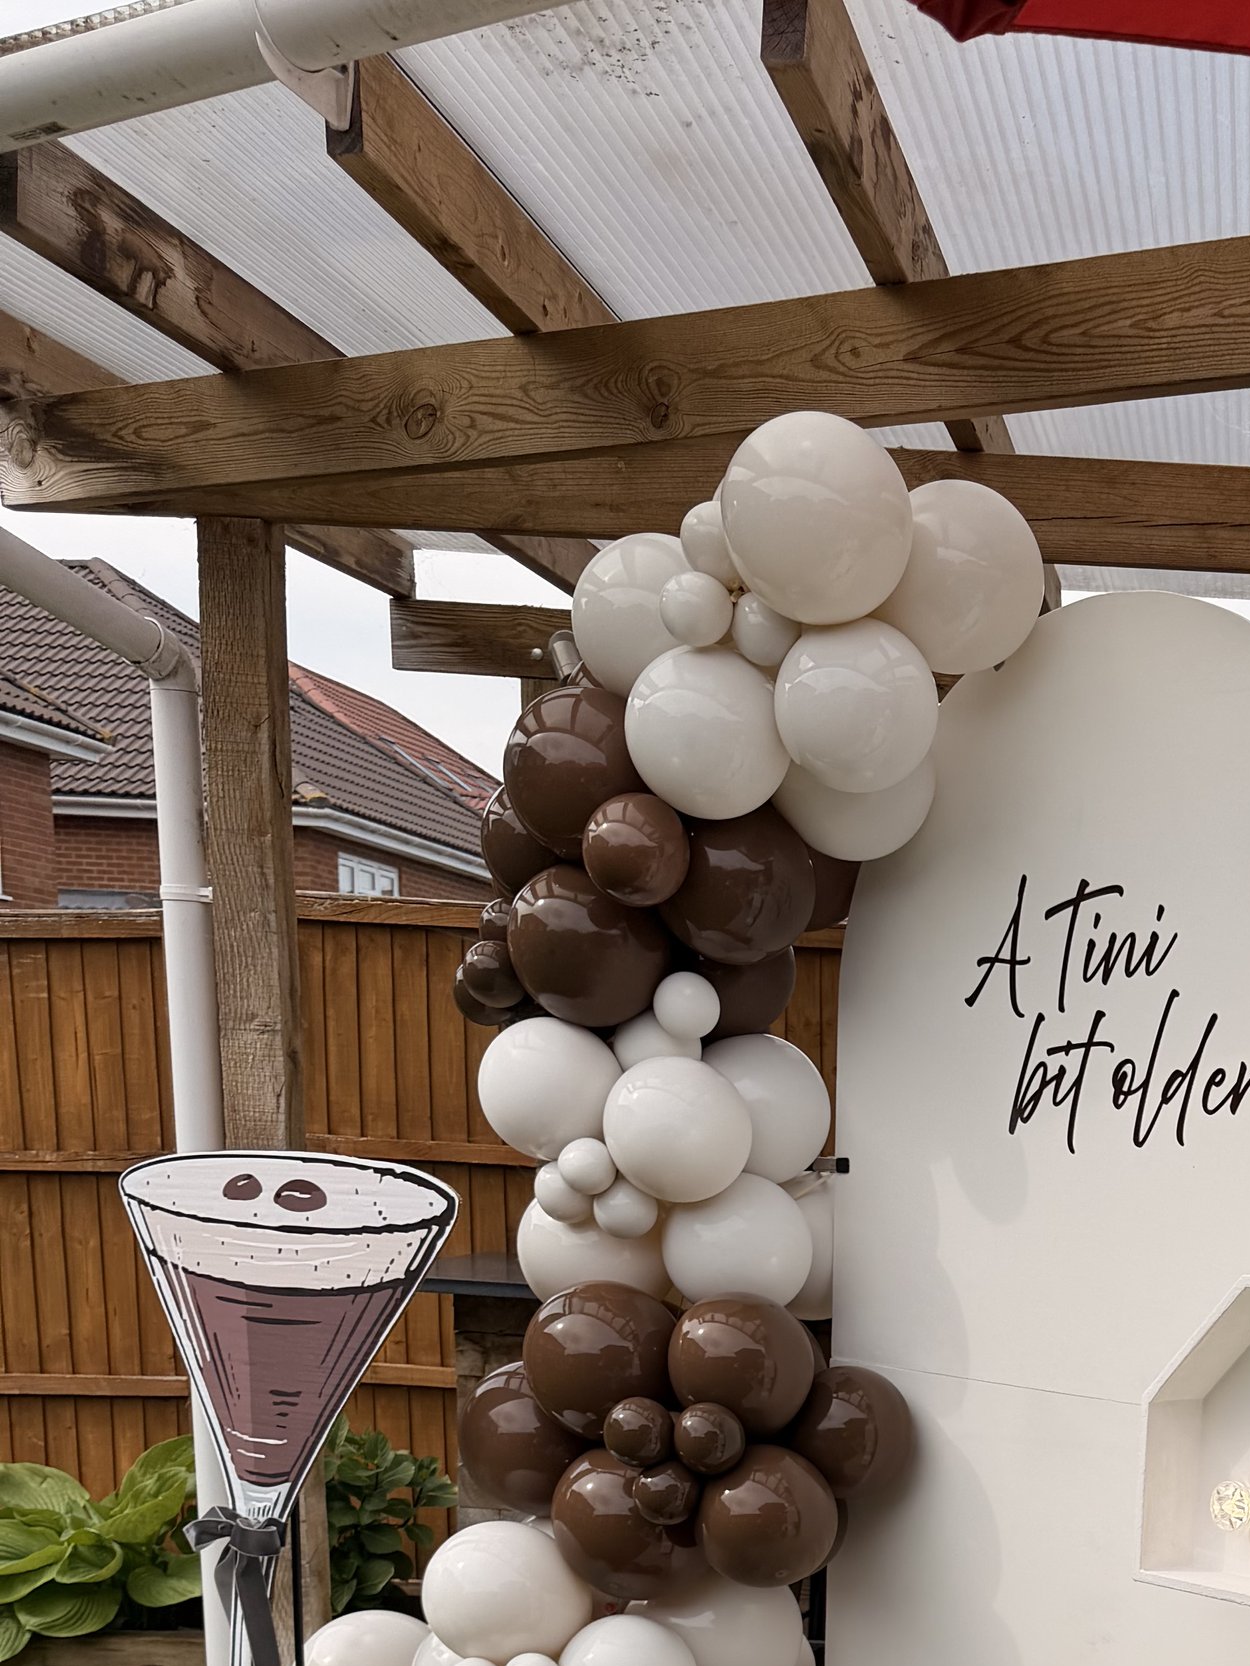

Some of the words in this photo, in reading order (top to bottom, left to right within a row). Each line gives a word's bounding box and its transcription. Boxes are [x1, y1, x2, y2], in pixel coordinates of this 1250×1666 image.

[964, 873, 1031, 1018] A
[1044, 878, 1178, 1014] Tini
[1008, 1009, 1115, 1155] bit
